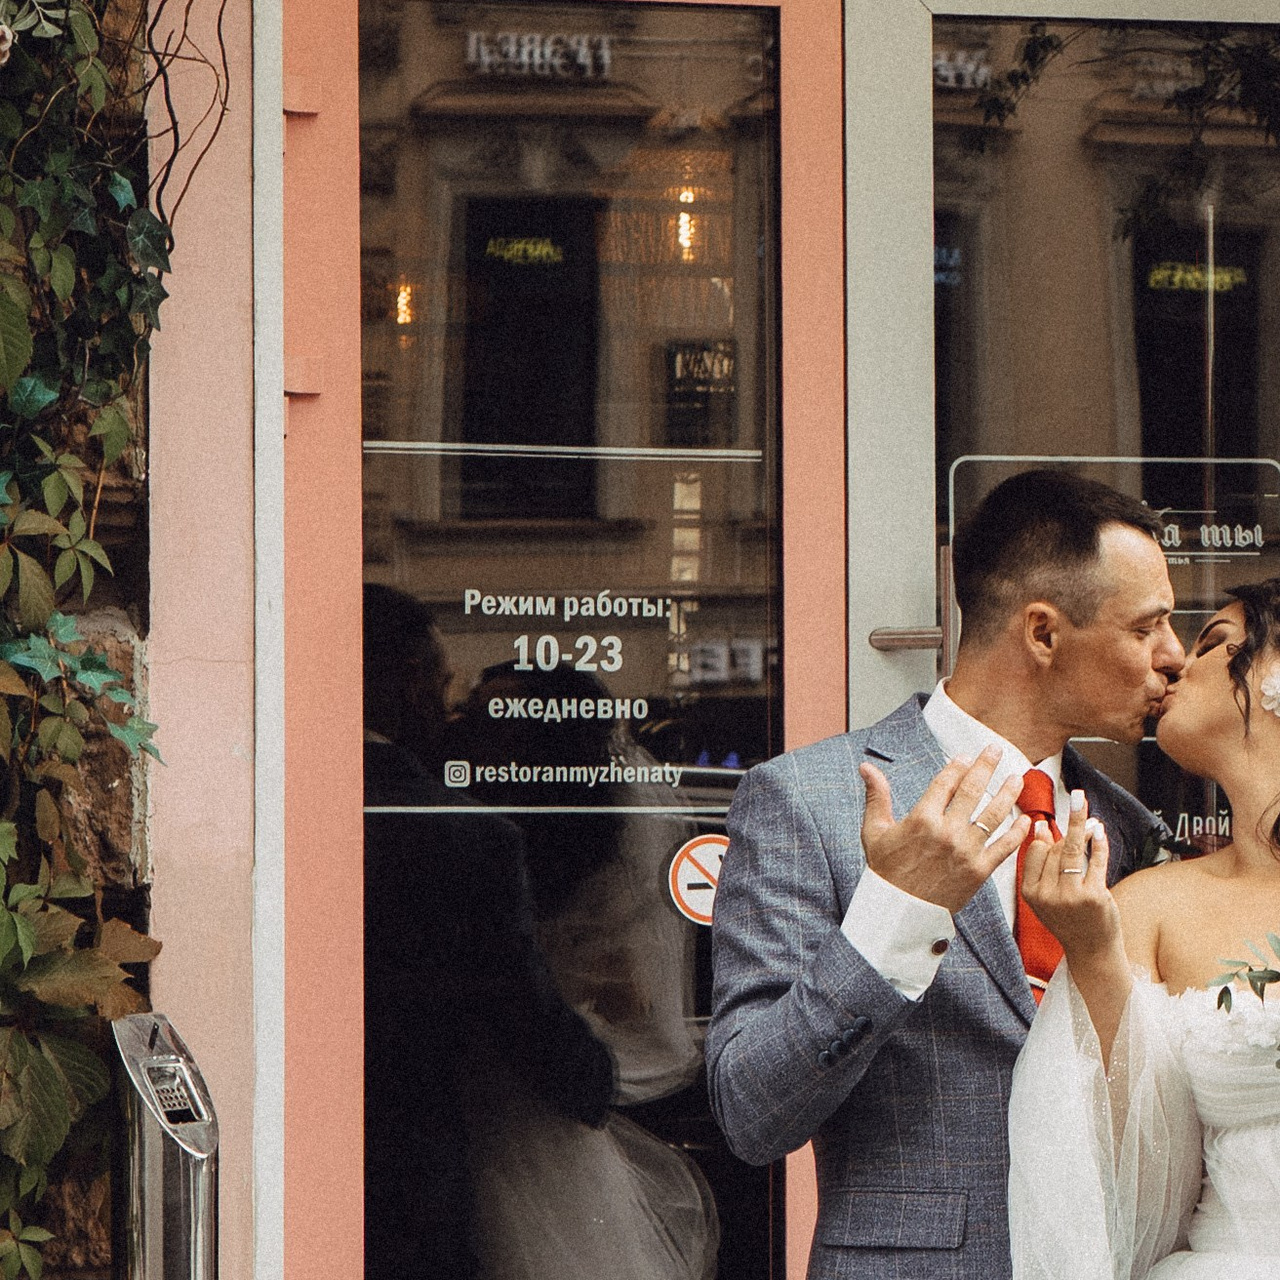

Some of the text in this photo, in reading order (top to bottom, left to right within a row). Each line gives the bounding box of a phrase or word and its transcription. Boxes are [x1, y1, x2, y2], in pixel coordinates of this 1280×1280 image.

[464, 588, 672, 622] Режим работы:
[513, 634, 624, 672] 10-23
[488, 697, 649, 722] ежедневно
[475, 761, 683, 788] restoranmyzhenaty
